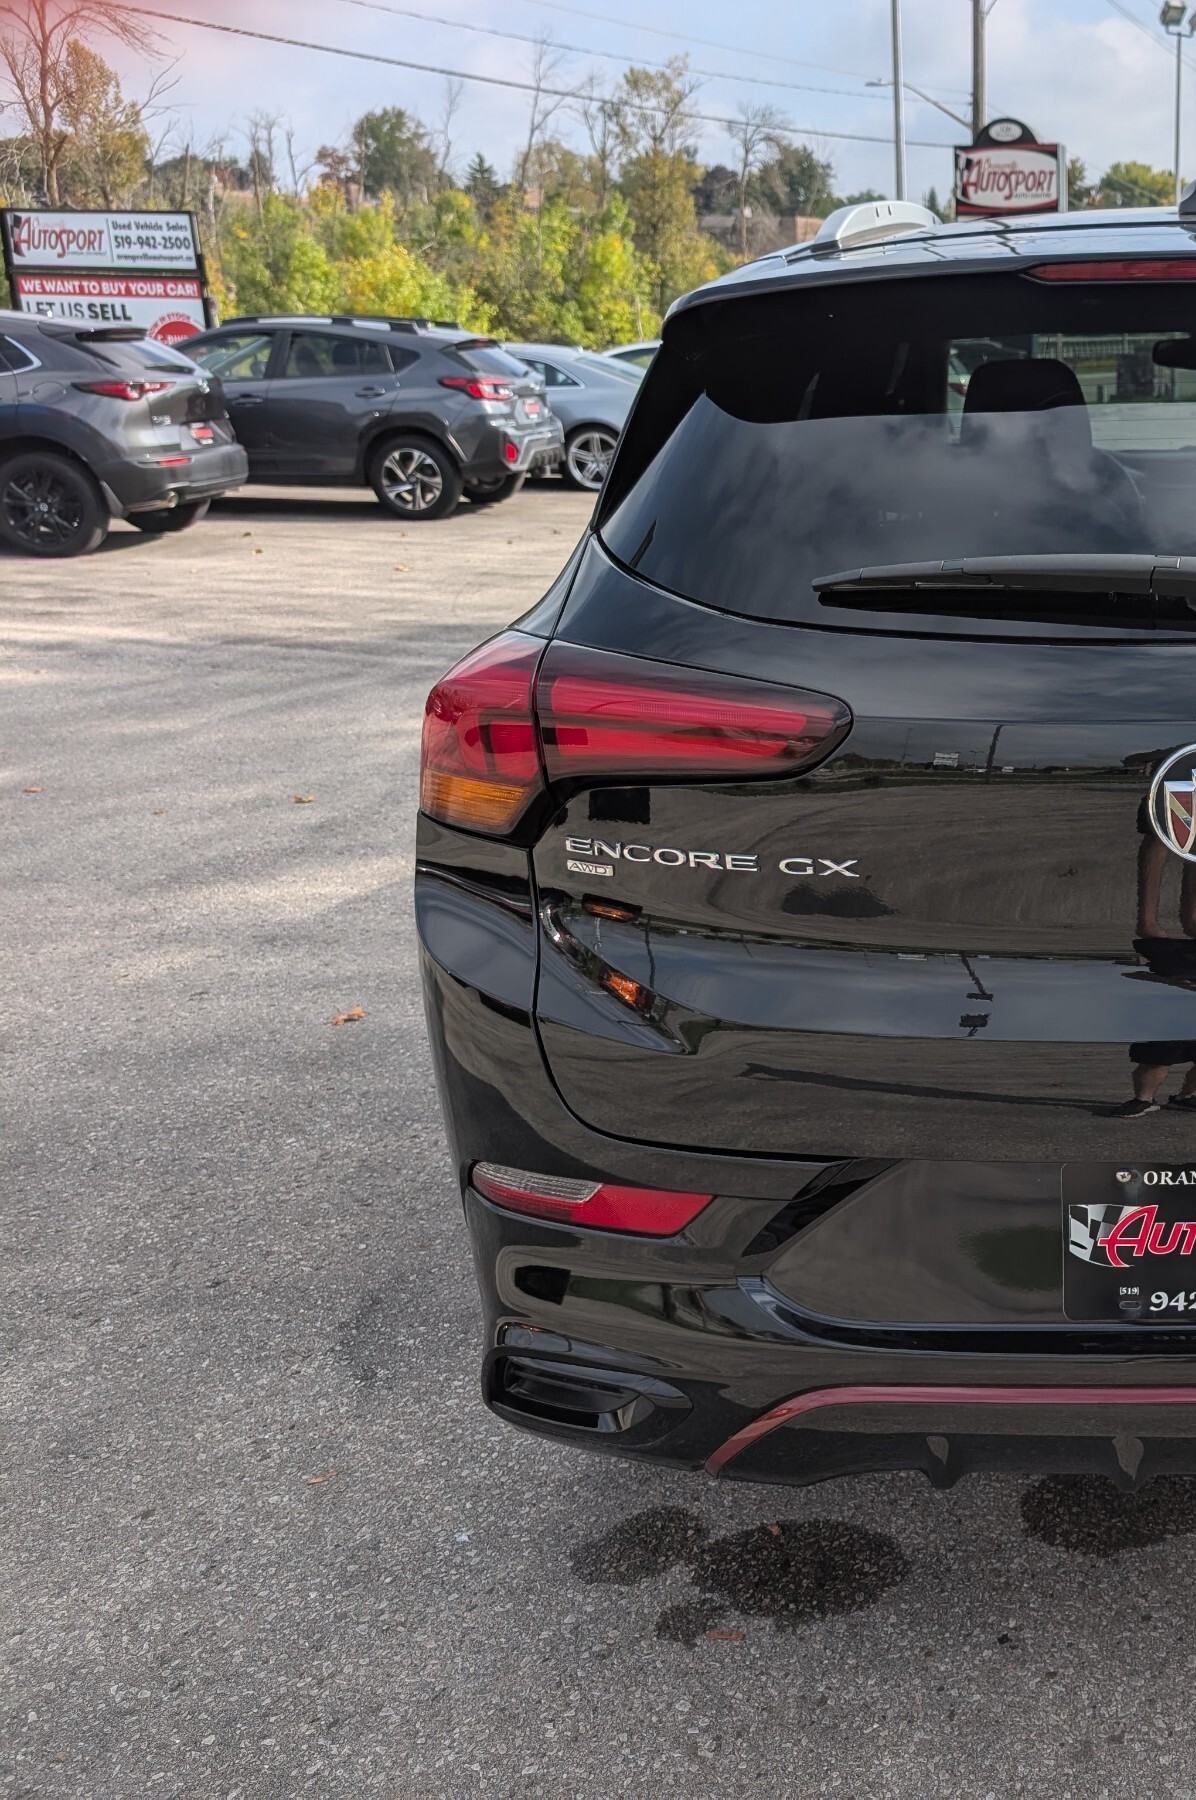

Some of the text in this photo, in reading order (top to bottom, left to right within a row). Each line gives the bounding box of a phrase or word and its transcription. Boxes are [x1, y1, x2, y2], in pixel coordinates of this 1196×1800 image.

[963, 159, 1055, 200] AUTOSPORT
[112, 221, 188, 232] Used Vehicle Sales
[15, 217, 105, 258] AUTOSPORT
[114, 235, 191, 250] 519-942-2500
[21, 280, 198, 297] WE WANT TO BUY YOUR CAR!
[87, 303, 132, 321] SELL
[565, 836, 860, 877] ENCORE GX
[568, 861, 611, 875] AWD
[1119, 1286, 1140, 1296] (519)
